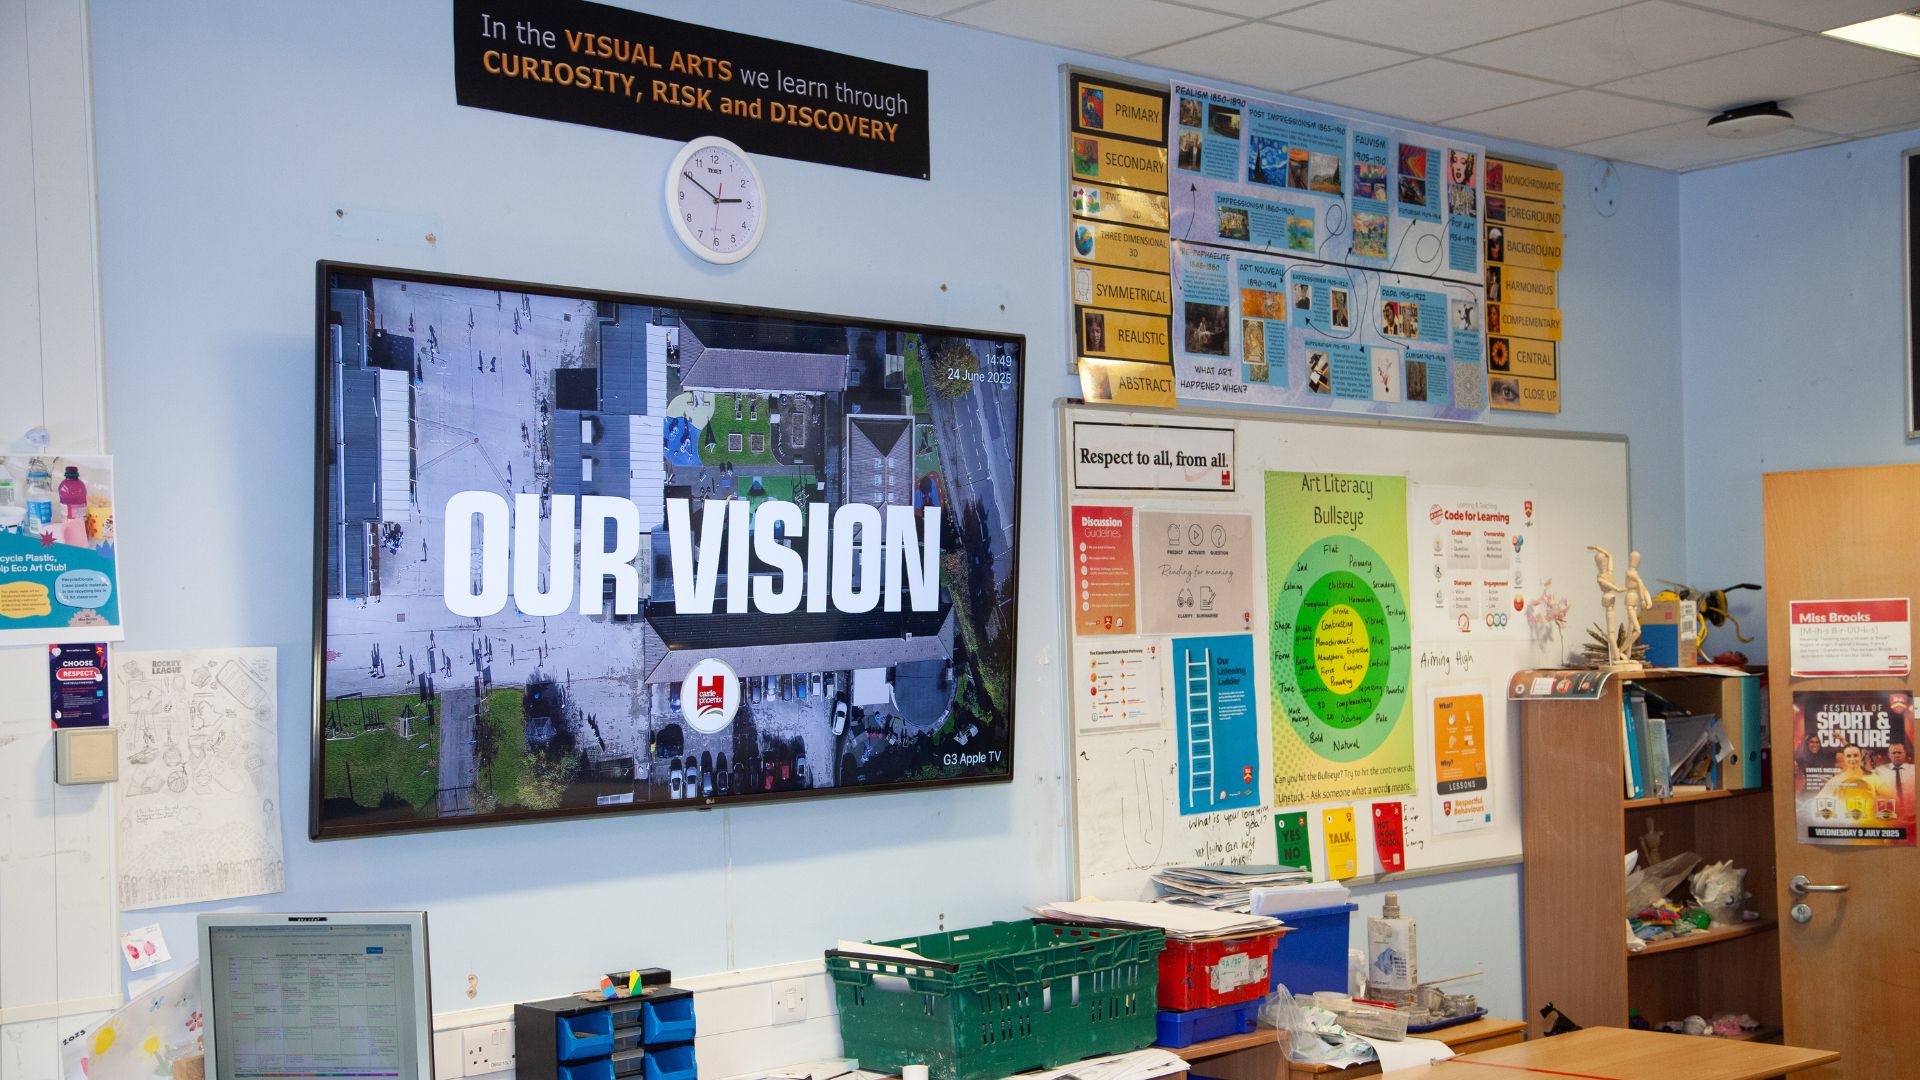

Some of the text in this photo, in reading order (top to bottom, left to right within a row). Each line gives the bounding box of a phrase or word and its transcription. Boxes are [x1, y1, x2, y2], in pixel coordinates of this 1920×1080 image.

[481, 14, 908, 117] In the VISUAL ARTS we learn through
[483, 50, 898, 142] CURIOSITY, RISK and DISCOVERY
[1175, 86, 1246, 108] REALISM 1850-1890
[1115, 103, 1160, 123] PRIMARY
[1249, 109, 1316, 129] POST IMPRESSIONISM
[1355, 136, 1386, 149] FAUVISM
[696, 159, 703, 168] 11
[710, 155, 719, 164] 12
[1105, 152, 1165, 174] SECONDARY
[741, 179, 746, 188] 2
[1504, 175, 1561, 193] MONOCHROMATIC
[679, 191, 685, 200] 9
[746, 201, 752, 210] 3
[1216, 195, 1265, 210] IMPRESSIONISM
[687, 213, 692, 222] 8
[1507, 206, 1561, 224] FOREGROUND
[741, 221, 747, 229] 4
[698, 230, 703, 238] 7
[731, 234, 736, 243] 5
[1101, 231, 1167, 249] THREE DIMENSIONAL
[714, 237, 720, 246] 6
[1129, 248, 1139, 258] 3D
[1507, 240, 1561, 258] BACKGROUND
[1239, 264, 1285, 277] ART NOUVEAU
[1096, 283, 1168, 304] SYMMETRICAL
[1382, 289, 1398, 298] DADA
[1506, 280, 1553, 296] HARMONIOUS
[1502, 314, 1560, 329] COMPLEMENTARY
[1118, 328, 1166, 346] REALISTIC
[985, 354, 1012, 367] 14:49
[1516, 351, 1552, 366] CENTRAL
[947, 367, 1012, 384] 24 June 2025
[1194, 366, 1233, 376] WHAT ART
[1119, 376, 1172, 393] ABSTRACT
[1180, 380, 1248, 394] HAPPENED WHEN?
[1523, 388, 1557, 401] CLOSE UP
[1080, 448, 1229, 469] Respect to all, from all.
[1302, 474, 1373, 500] Art Literacy
[1081, 516, 1123, 528] Discussion
[1314, 505, 1364, 531] Bullseye
[1444, 510, 1510, 525] Code for Learning
[1085, 528, 1120, 538] Guidelines
[444, 490, 941, 617] OUR VISION
[1323, 544, 1339, 555] Flat
[25, 554, 57, 563] Plastic,
[1349, 554, 1372, 573] Primary
[11, 563, 67, 572] Eco Art Club!
[1297, 562, 1308, 572] Sad
[1158, 564, 1234, 584] Reading for meaning
[1284, 582, 1303, 596] Calming
[1799, 612, 1871, 623] Miss Brooks
[1274, 621, 1292, 634] Shape
[1322, 620, 1353, 635] Contrasting
[1315, 637, 1355, 647] Monochromatic
[1216, 657, 1230, 666] Our
[1275, 650, 1290, 660] Form
[1420, 650, 1474, 676] Aiming High
[152, 667, 182, 675] LEAGUE
[1217, 666, 1246, 677] Listening
[1217, 678, 1241, 686] Ladder
[1279, 682, 1295, 695] Tone
[1330, 675, 1353, 689] Provoking
[1385, 685, 1405, 695] Powerful
[699, 695, 723, 705] phoenix
[1823, 704, 1883, 712] FESTIVAL OF
[1376, 713, 1388, 723] Pale
[1816, 711, 1891, 730] SPORT &
[1310, 731, 1324, 744] Bold
[1817, 729, 1891, 748] CULTURE
[1333, 738, 1360, 752] Natural
[943, 750, 1002, 766] G3 Apple TV
[1440, 760, 1453, 768] Why?
[1275, 775, 1286, 784] Can
[1286, 776, 1298, 786] you
[1307, 773, 1317, 781] the
[1344, 769, 1354, 780] Try
[1361, 767, 1369, 776] hit
[1370, 766, 1379, 775] the
[1379, 766, 1397, 775] centre
[1449, 780, 1476, 791] LESSONS
[1278, 792, 1305, 804] Unstuck
[1311, 790, 1321, 800] Ask
[1322, 788, 1351, 798] someone
[1351, 787, 1366, 795] what
[1455, 796, 1483, 807] Respectful
[1454, 805, 1485, 816] Behaviours
[1189, 811, 1240, 830] What is your
[1282, 829, 1301, 843] YES
[1328, 832, 1353, 845] TALK.
[1815, 828, 1900, 838] WEDNESDAY 9 JULY 2025
[1225, 842, 1238, 852] can
[1284, 847, 1300, 860] NO
